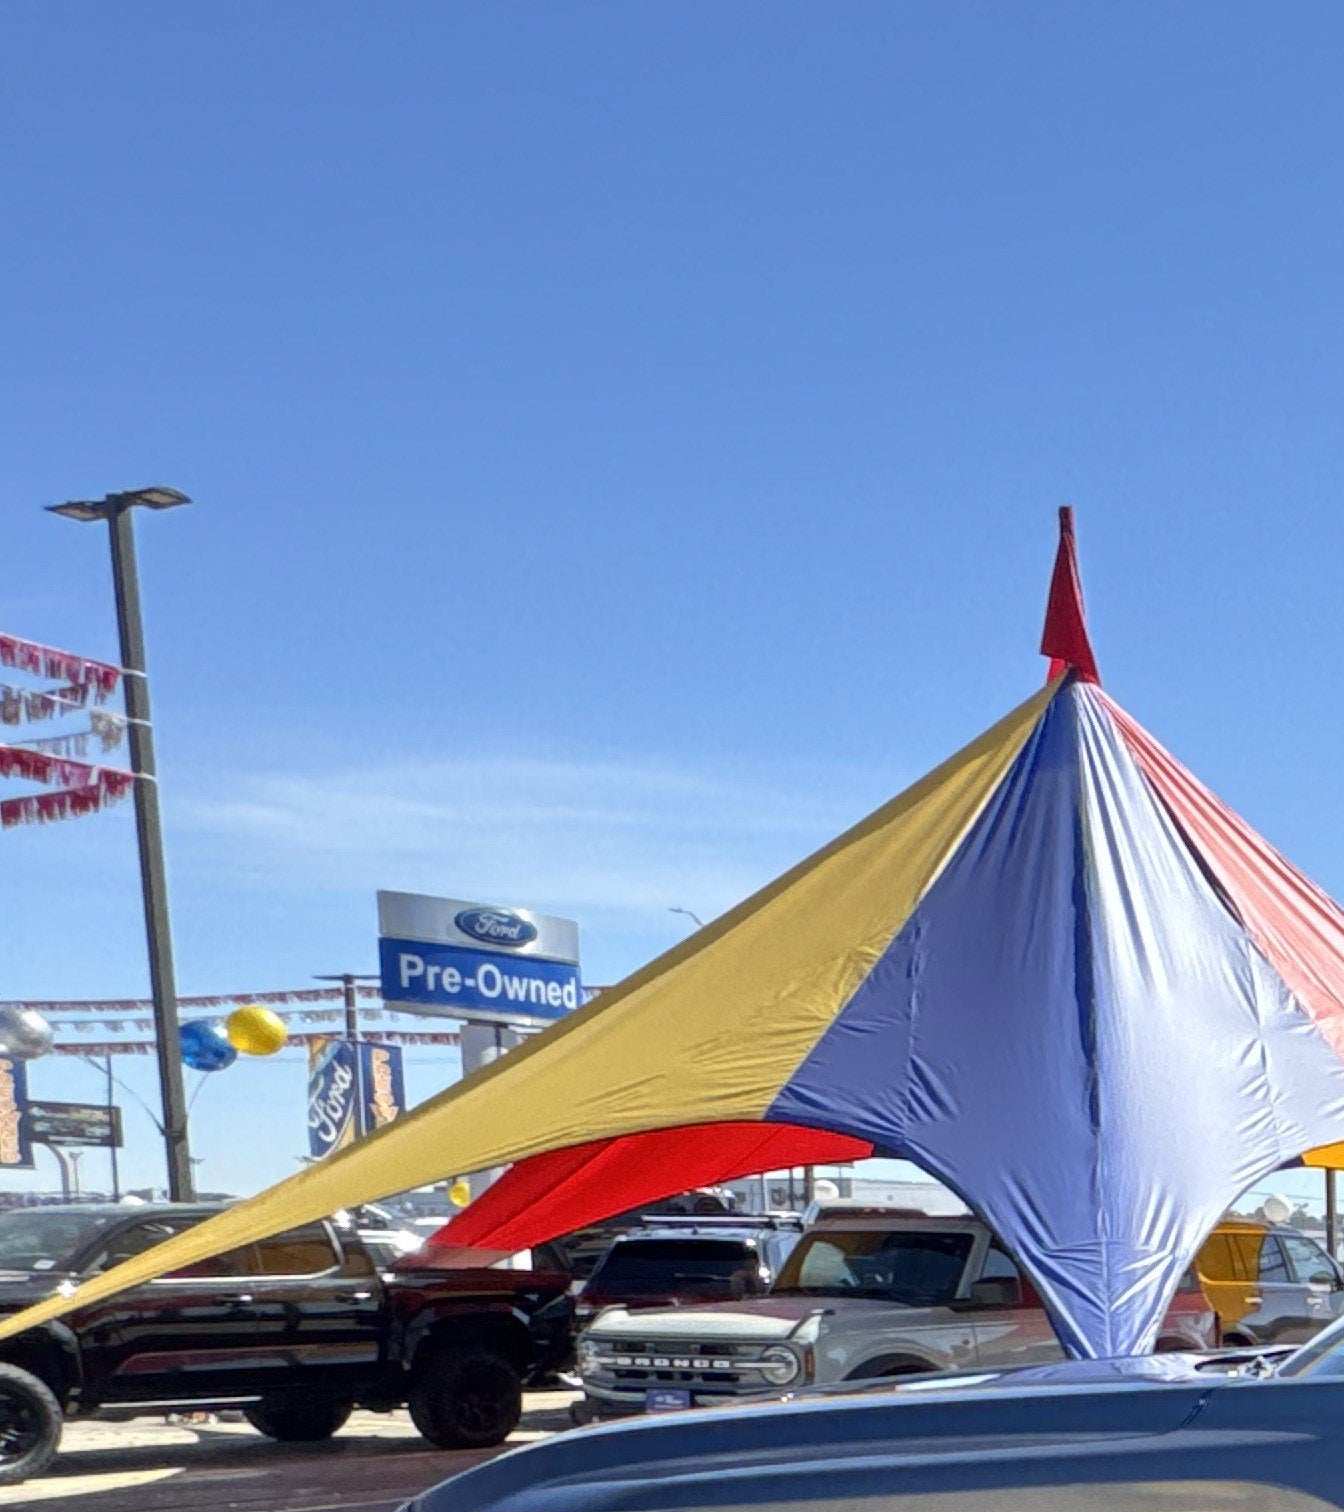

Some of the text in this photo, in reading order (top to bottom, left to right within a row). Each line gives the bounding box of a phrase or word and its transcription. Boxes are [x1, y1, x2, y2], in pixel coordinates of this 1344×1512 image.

[473, 912, 522, 940] Ford
[398, 952, 577, 1010] Pre-Owned
[308, 1059, 353, 1142] Ford
